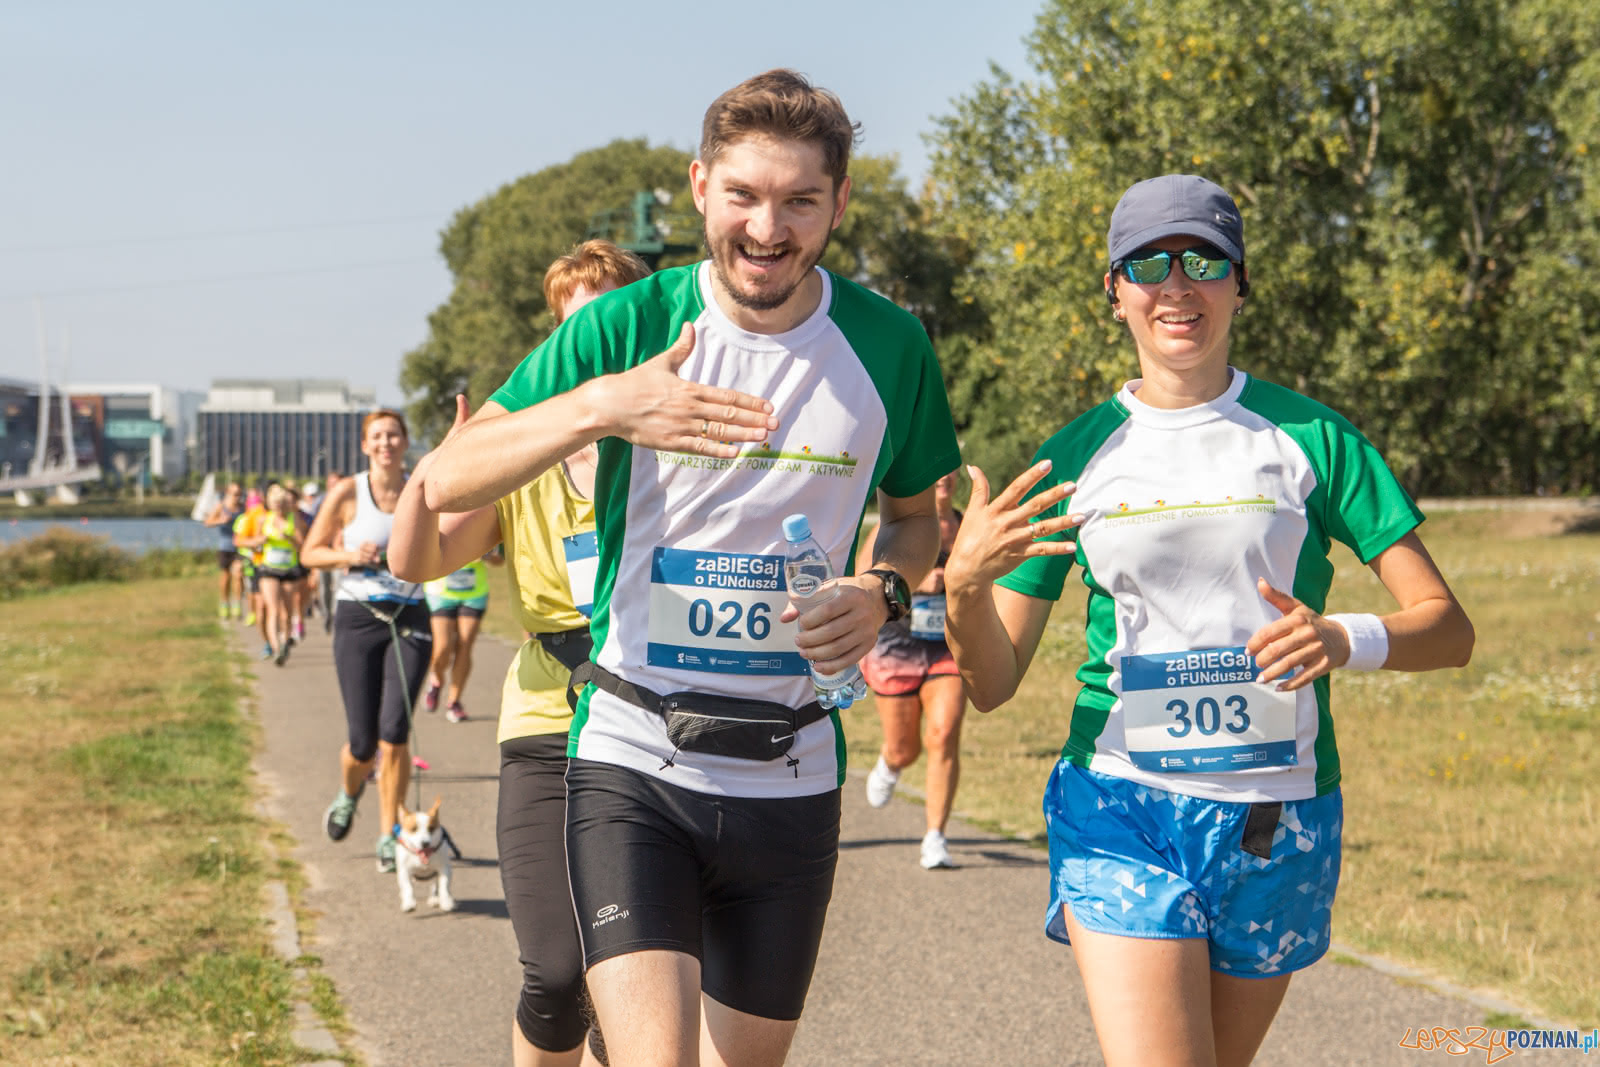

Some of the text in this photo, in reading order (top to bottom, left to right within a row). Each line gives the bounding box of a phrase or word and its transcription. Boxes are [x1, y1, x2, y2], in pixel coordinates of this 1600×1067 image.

[1182, 508, 1229, 518] POMAGAM
[1232, 504, 1277, 514] AKTYWNIE
[696, 557, 779, 577] zaBIEGaj
[695, 576, 704, 585] o
[708, 574, 778, 589] FUNdusze
[688, 598, 771, 641] 026
[1165, 652, 1251, 672] zaBIEGaj
[1167, 670, 1252, 686] o FUNdusze
[1165, 695, 1251, 738] 303
